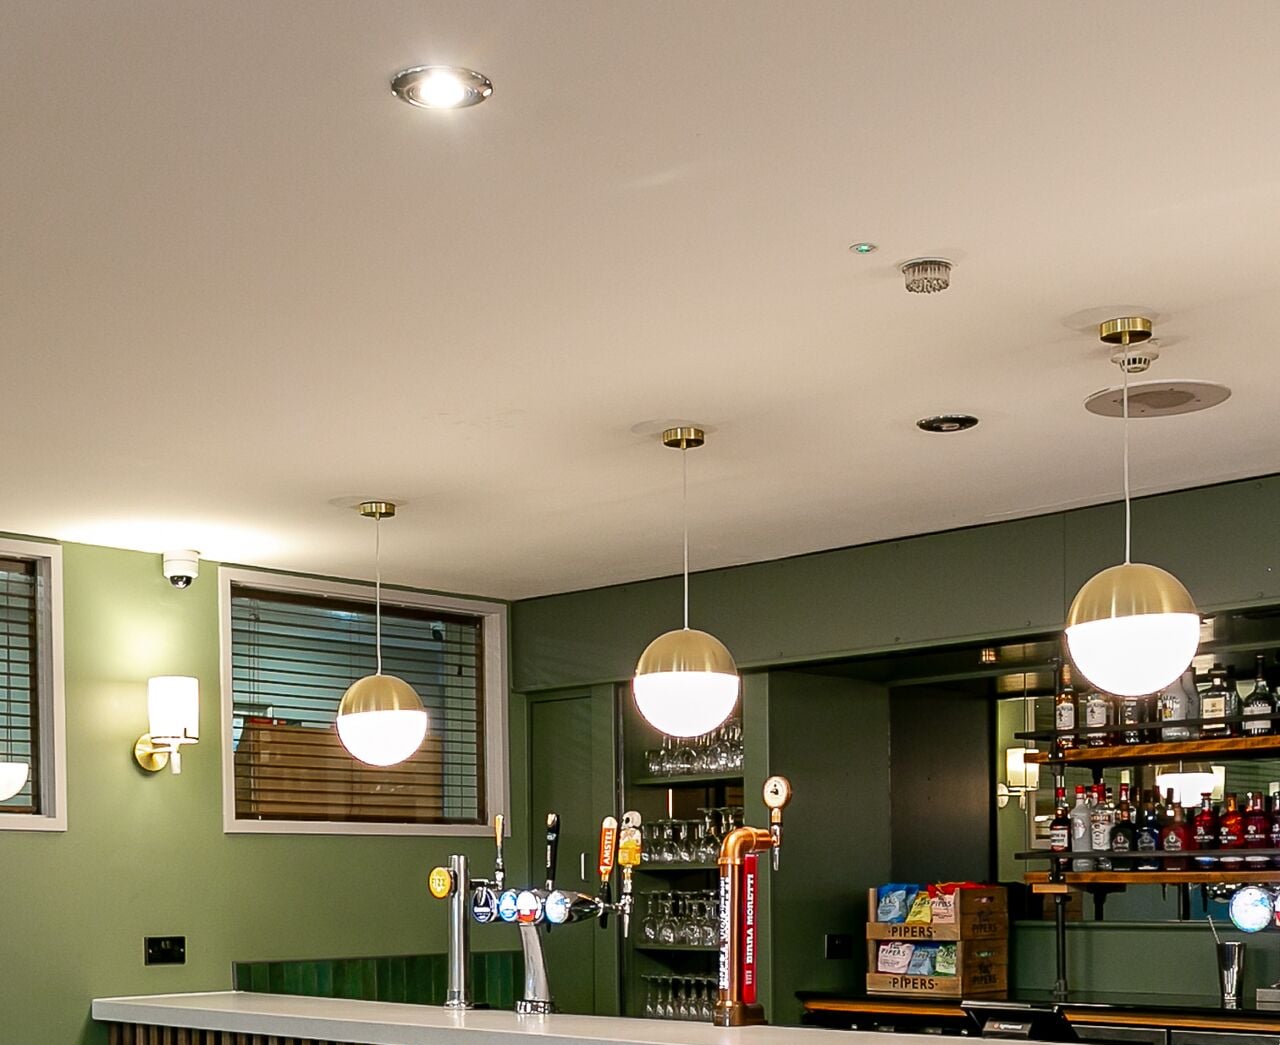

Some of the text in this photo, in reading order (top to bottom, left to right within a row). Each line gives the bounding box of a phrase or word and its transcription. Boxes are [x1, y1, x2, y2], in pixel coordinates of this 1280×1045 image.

[603, 829, 613, 865] AMSTEL
[892, 926, 933, 938] PIPERS
[746, 928, 754, 964] BIRRA
[892, 977, 934, 990] PIPERS
